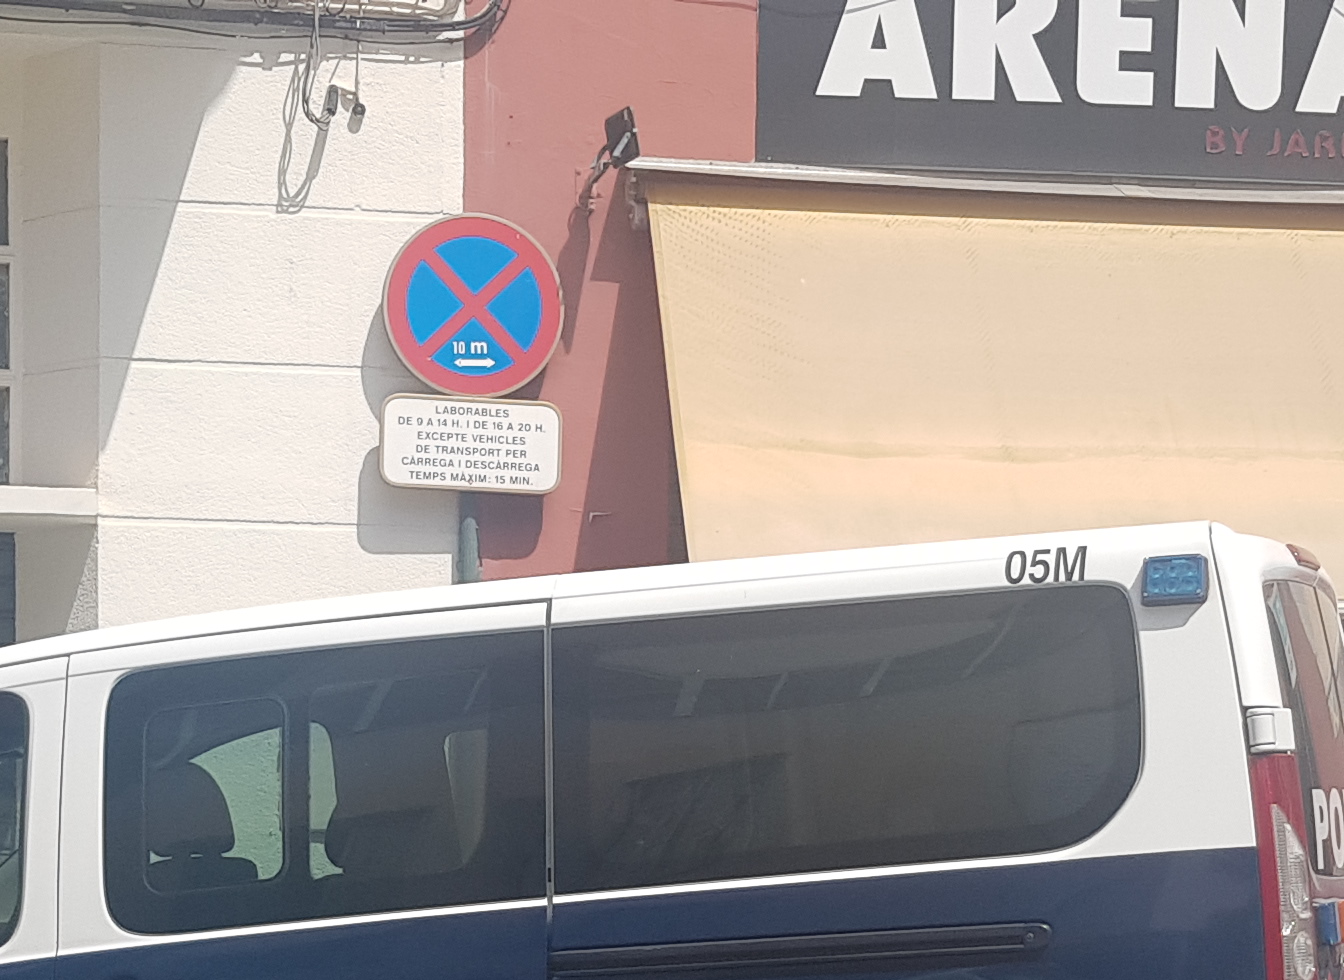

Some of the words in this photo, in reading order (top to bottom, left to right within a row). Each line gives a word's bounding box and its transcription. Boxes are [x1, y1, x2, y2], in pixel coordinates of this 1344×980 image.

[1205, 126, 1250, 155] BY
[452, 341, 466, 354] 10
[470, 341, 488, 354] m
[435, 405, 510, 418] LABORABLES
[397, 416, 413, 426] DE
[416, 417, 423, 426] 9
[426, 418, 433, 426] A
[437, 418, 447, 427] 14
[451, 419, 463, 428] H.
[473, 420, 488, 430] DE
[492, 421, 503, 431] 16
[506, 422, 513, 431] A
[517, 423, 531, 432] 20
[535, 424, 546, 433] H.
[417, 431, 468, 442] EXCEPTE
[471, 434, 526, 445] VEHICLES
[416, 444, 431, 454] DE
[434, 445, 502, 457] TRANSPORT
[505, 449, 527, 458] PER
[409, 470, 446, 481] TEMPS
[494, 475, 506, 484] 15
[509, 476, 534, 486] MIN.
[1004, 545, 1088, 585] 05M
